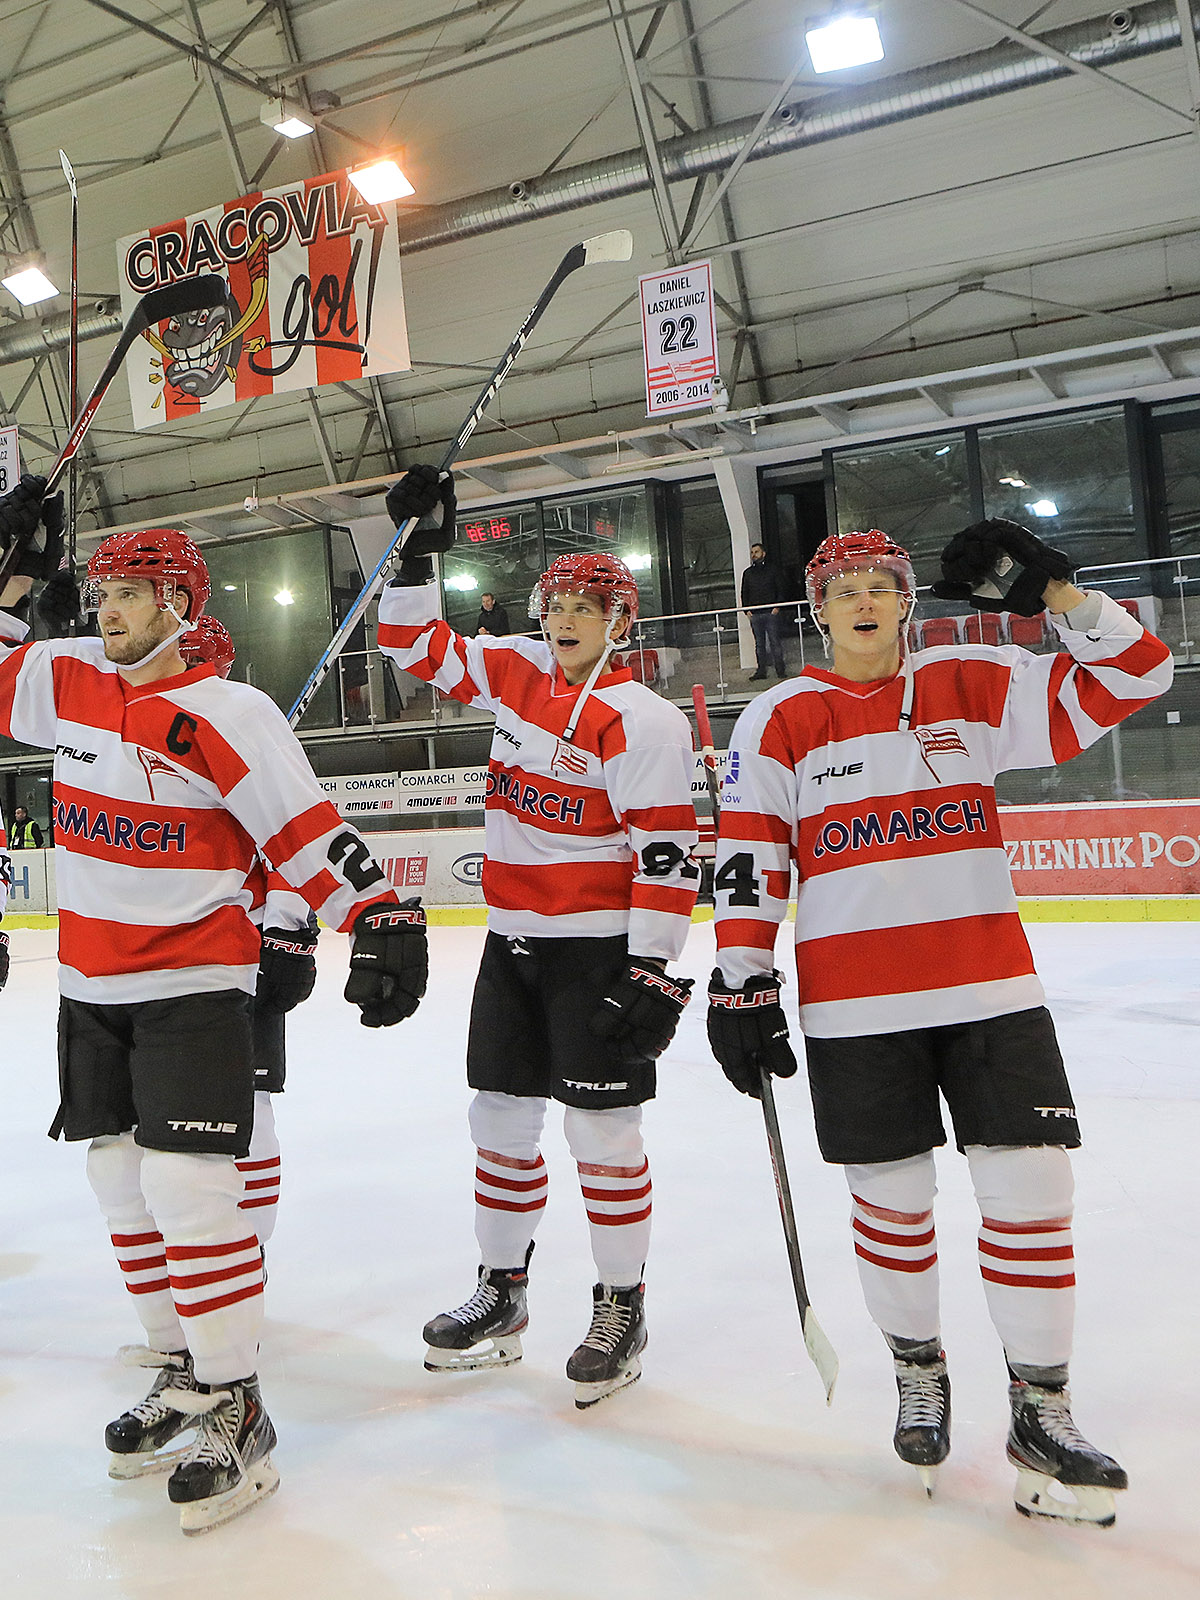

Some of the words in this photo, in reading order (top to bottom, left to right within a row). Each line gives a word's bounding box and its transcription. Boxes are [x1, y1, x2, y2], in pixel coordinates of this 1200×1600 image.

[125, 180, 390, 295] CRACOVIA
[659, 276, 692, 295] DANIEL
[248, 224, 388, 377] gol!
[647, 291, 706, 316] LASZKIEWICZ
[659, 313, 699, 356] 22
[457, 327, 535, 450] TRUE
[655, 389, 679, 405] 2006
[686, 383, 710, 399] 2014
[71, 407, 95, 447] TRUE
[165, 711, 198, 756] C
[345, 778, 395, 791] COMARCH
[401, 773, 456, 787] COMARCH
[810, 760, 865, 786] TRUE
[344, 800, 379, 812] 4MOVE
[406, 796, 443, 808] 4MOVE
[463, 794, 487, 805] 4MO
[486, 771, 586, 827] OMARCH
[1002, 836, 1137, 871] ZIENNIK
[1138, 831, 1200, 869] PO
[365, 909, 427, 930] TRU
[629, 965, 693, 1007] TRU
[562, 1078, 630, 1091] TRUE
[1033, 1106, 1079, 1119] TRU
[167, 1119, 239, 1134] TRUE
